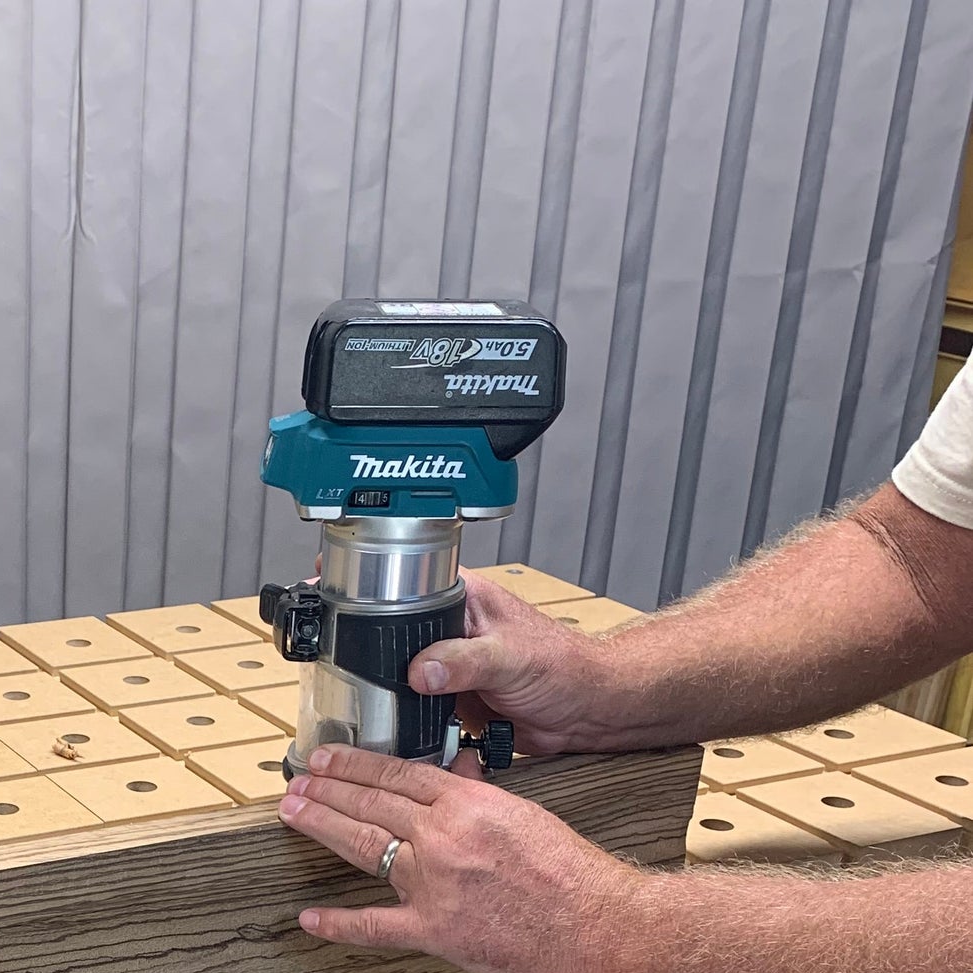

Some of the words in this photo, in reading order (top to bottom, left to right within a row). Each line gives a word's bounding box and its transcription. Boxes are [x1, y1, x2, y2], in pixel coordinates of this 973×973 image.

[346, 339, 415, 352] LITHIUM-ION
[410, 338, 466, 367] 18V
[485, 340, 531, 357] 5.0Ah
[315, 488, 344, 500] LXT
